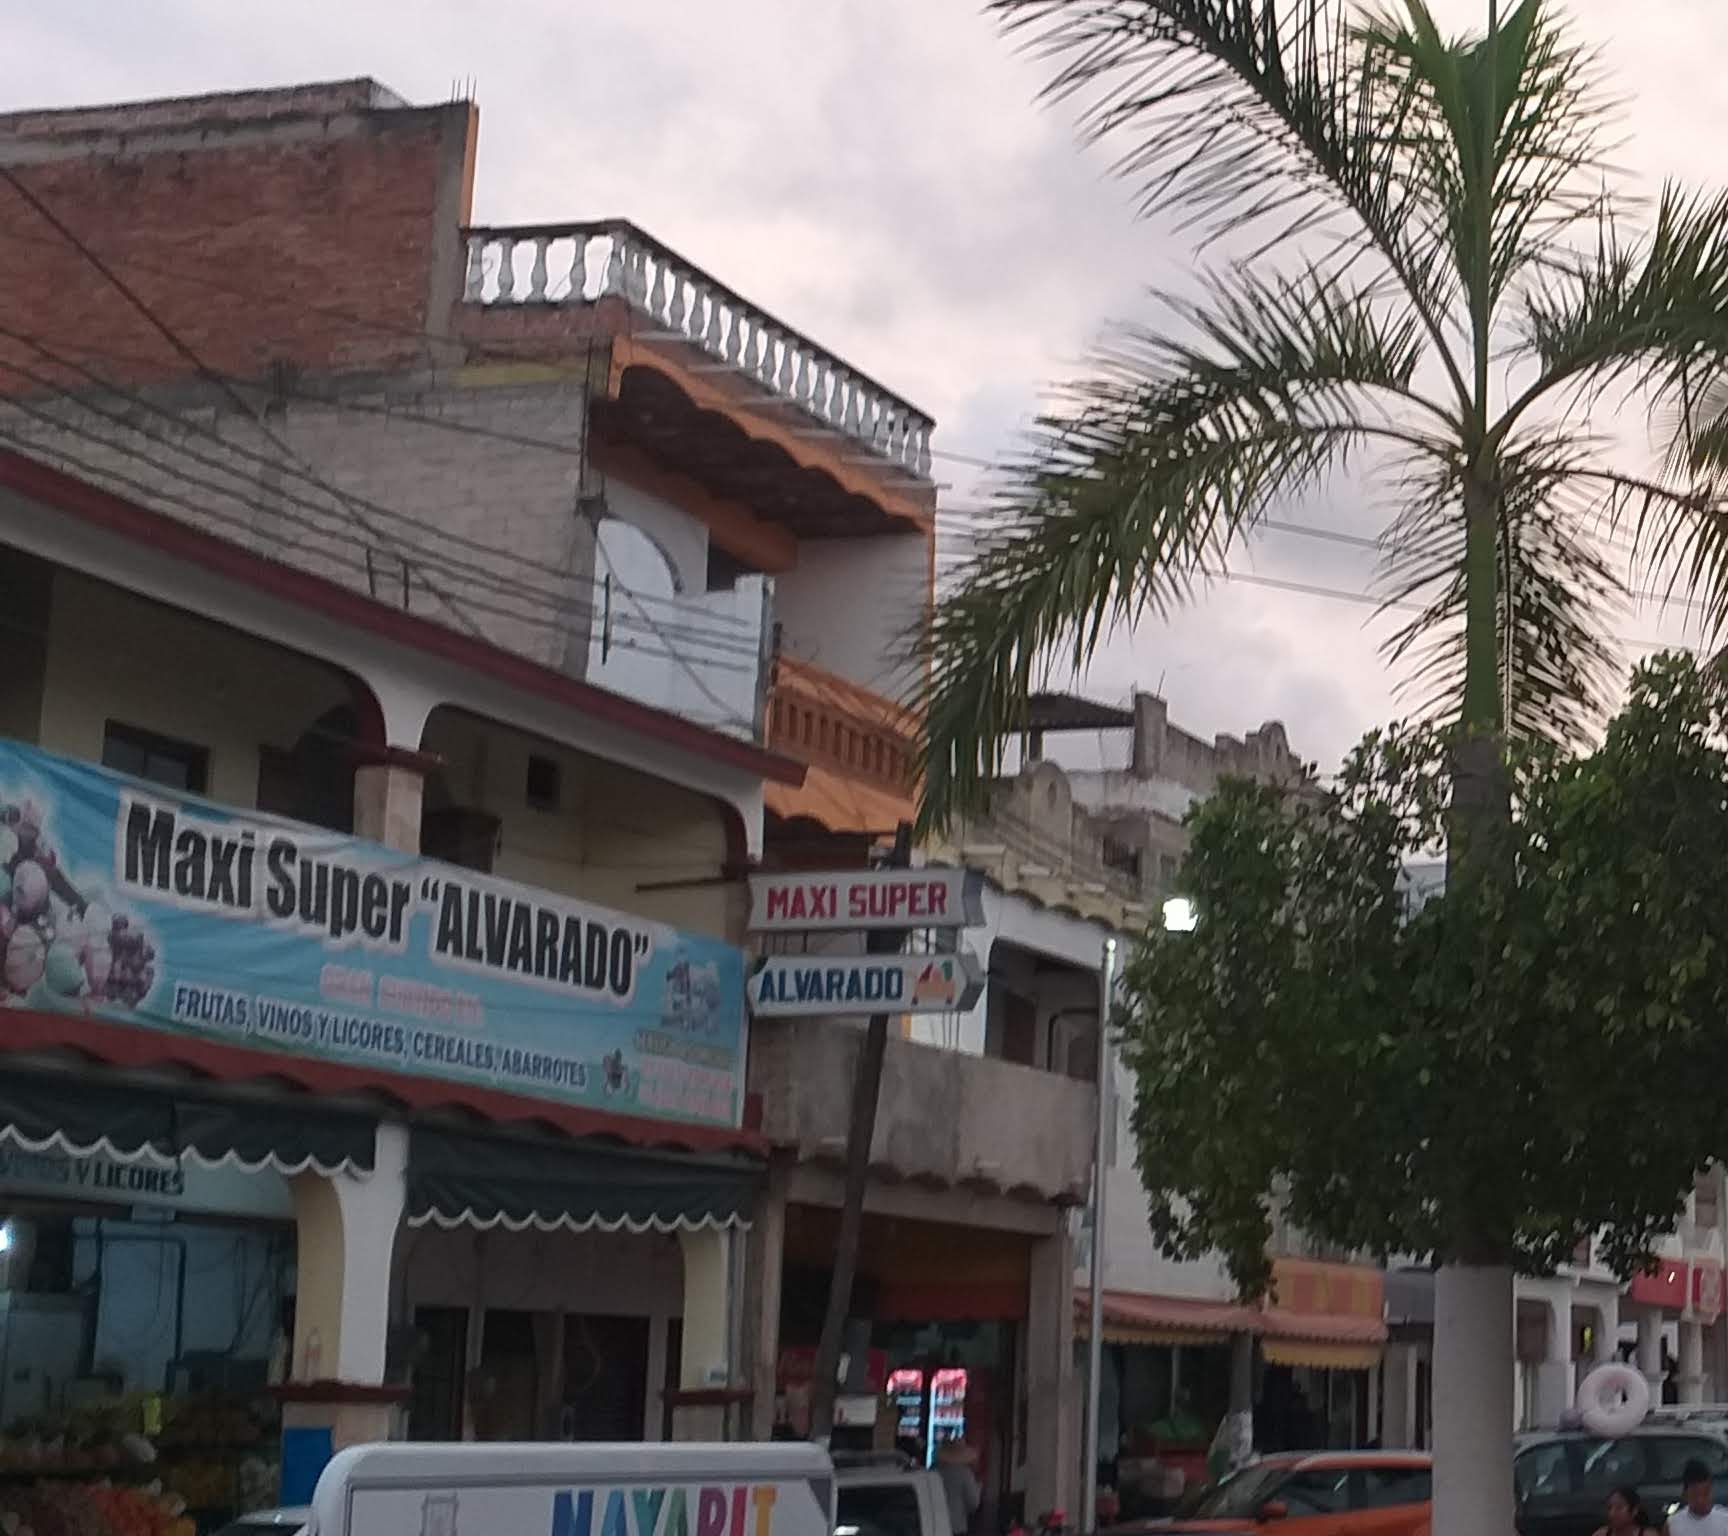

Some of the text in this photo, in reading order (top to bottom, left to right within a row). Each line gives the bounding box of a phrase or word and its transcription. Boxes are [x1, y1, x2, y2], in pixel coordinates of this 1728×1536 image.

[125, 801, 255, 908] Maxi
[266, 837, 411, 943] Super
[767, 881, 948, 920] MAXI SUPER
[758, 966, 904, 1002] ALVARADO
[257, 1000, 313, 1038] VINOS
[317, 1012, 330, 1041] Y
[501, 1048, 587, 1087] ABARROTES
[93, 1161, 185, 1195] LICORES
